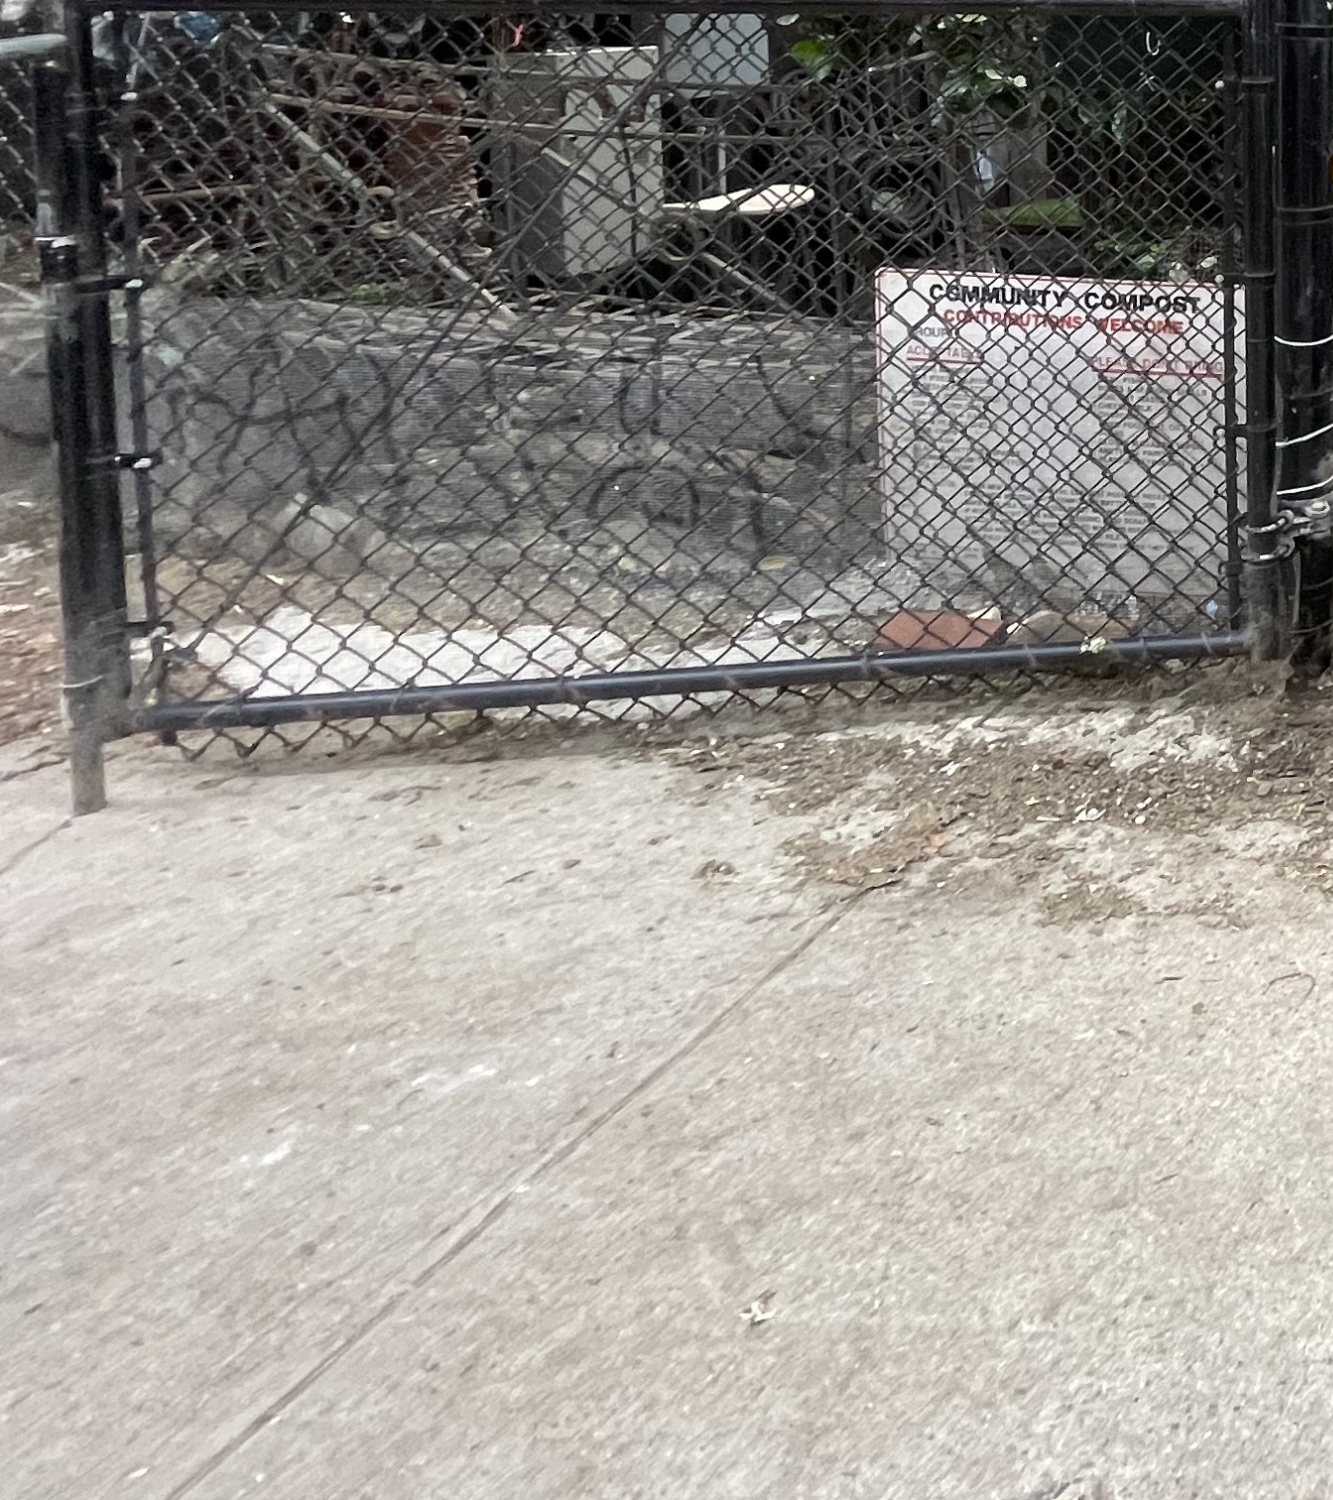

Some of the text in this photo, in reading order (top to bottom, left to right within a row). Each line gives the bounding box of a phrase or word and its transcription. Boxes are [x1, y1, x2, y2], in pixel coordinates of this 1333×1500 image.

[929, 283, 1201, 314] COMMUNITY COMPOST
[943, 308, 1185, 335] CONTRIBUTIONS WELCOME
